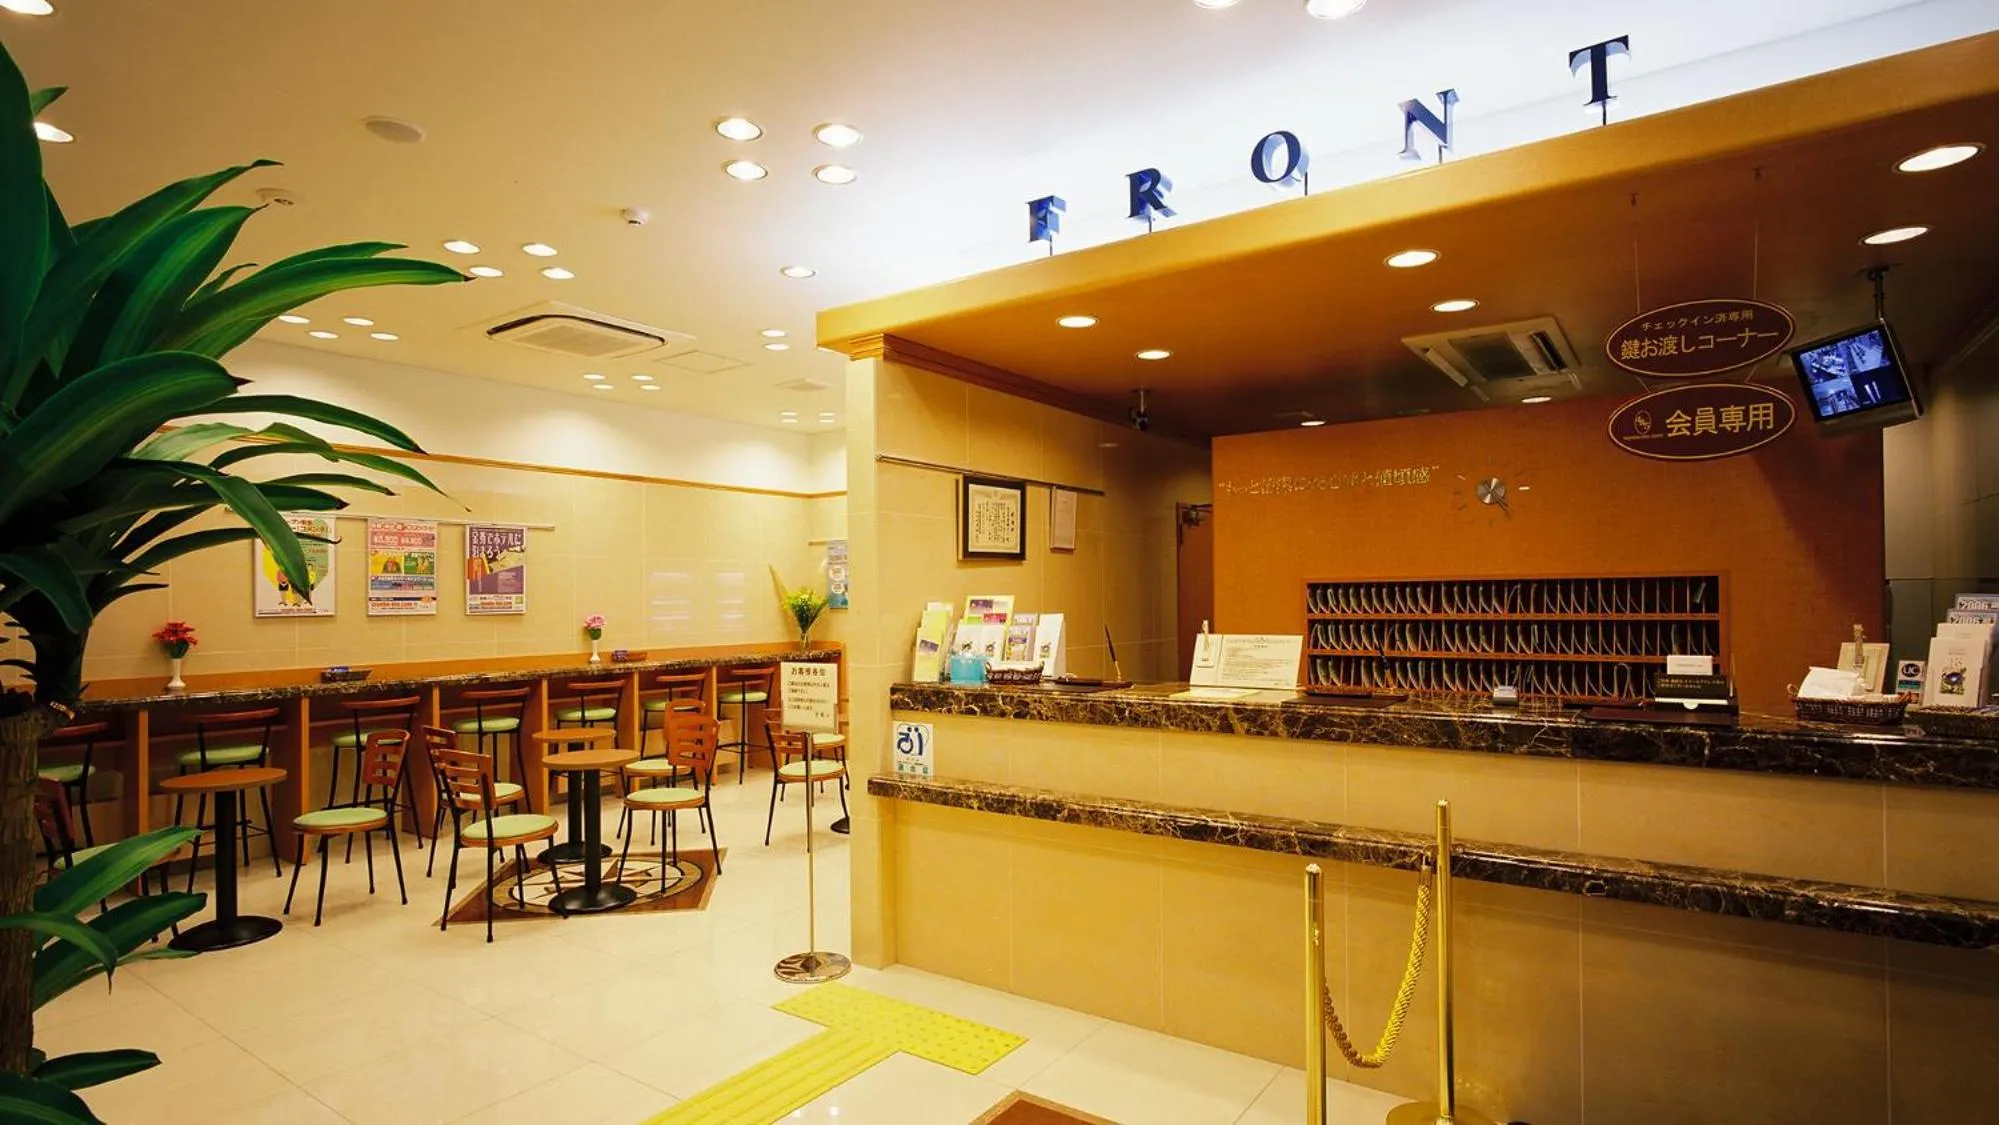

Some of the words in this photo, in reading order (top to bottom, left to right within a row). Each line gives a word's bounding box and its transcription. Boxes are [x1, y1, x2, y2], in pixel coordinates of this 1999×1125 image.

[1028, 35, 1631, 242] FRONT
[1621, 328, 1778, 360] 鍵お渡しコーナー
[1666, 403, 1774, 437] 会員専用
